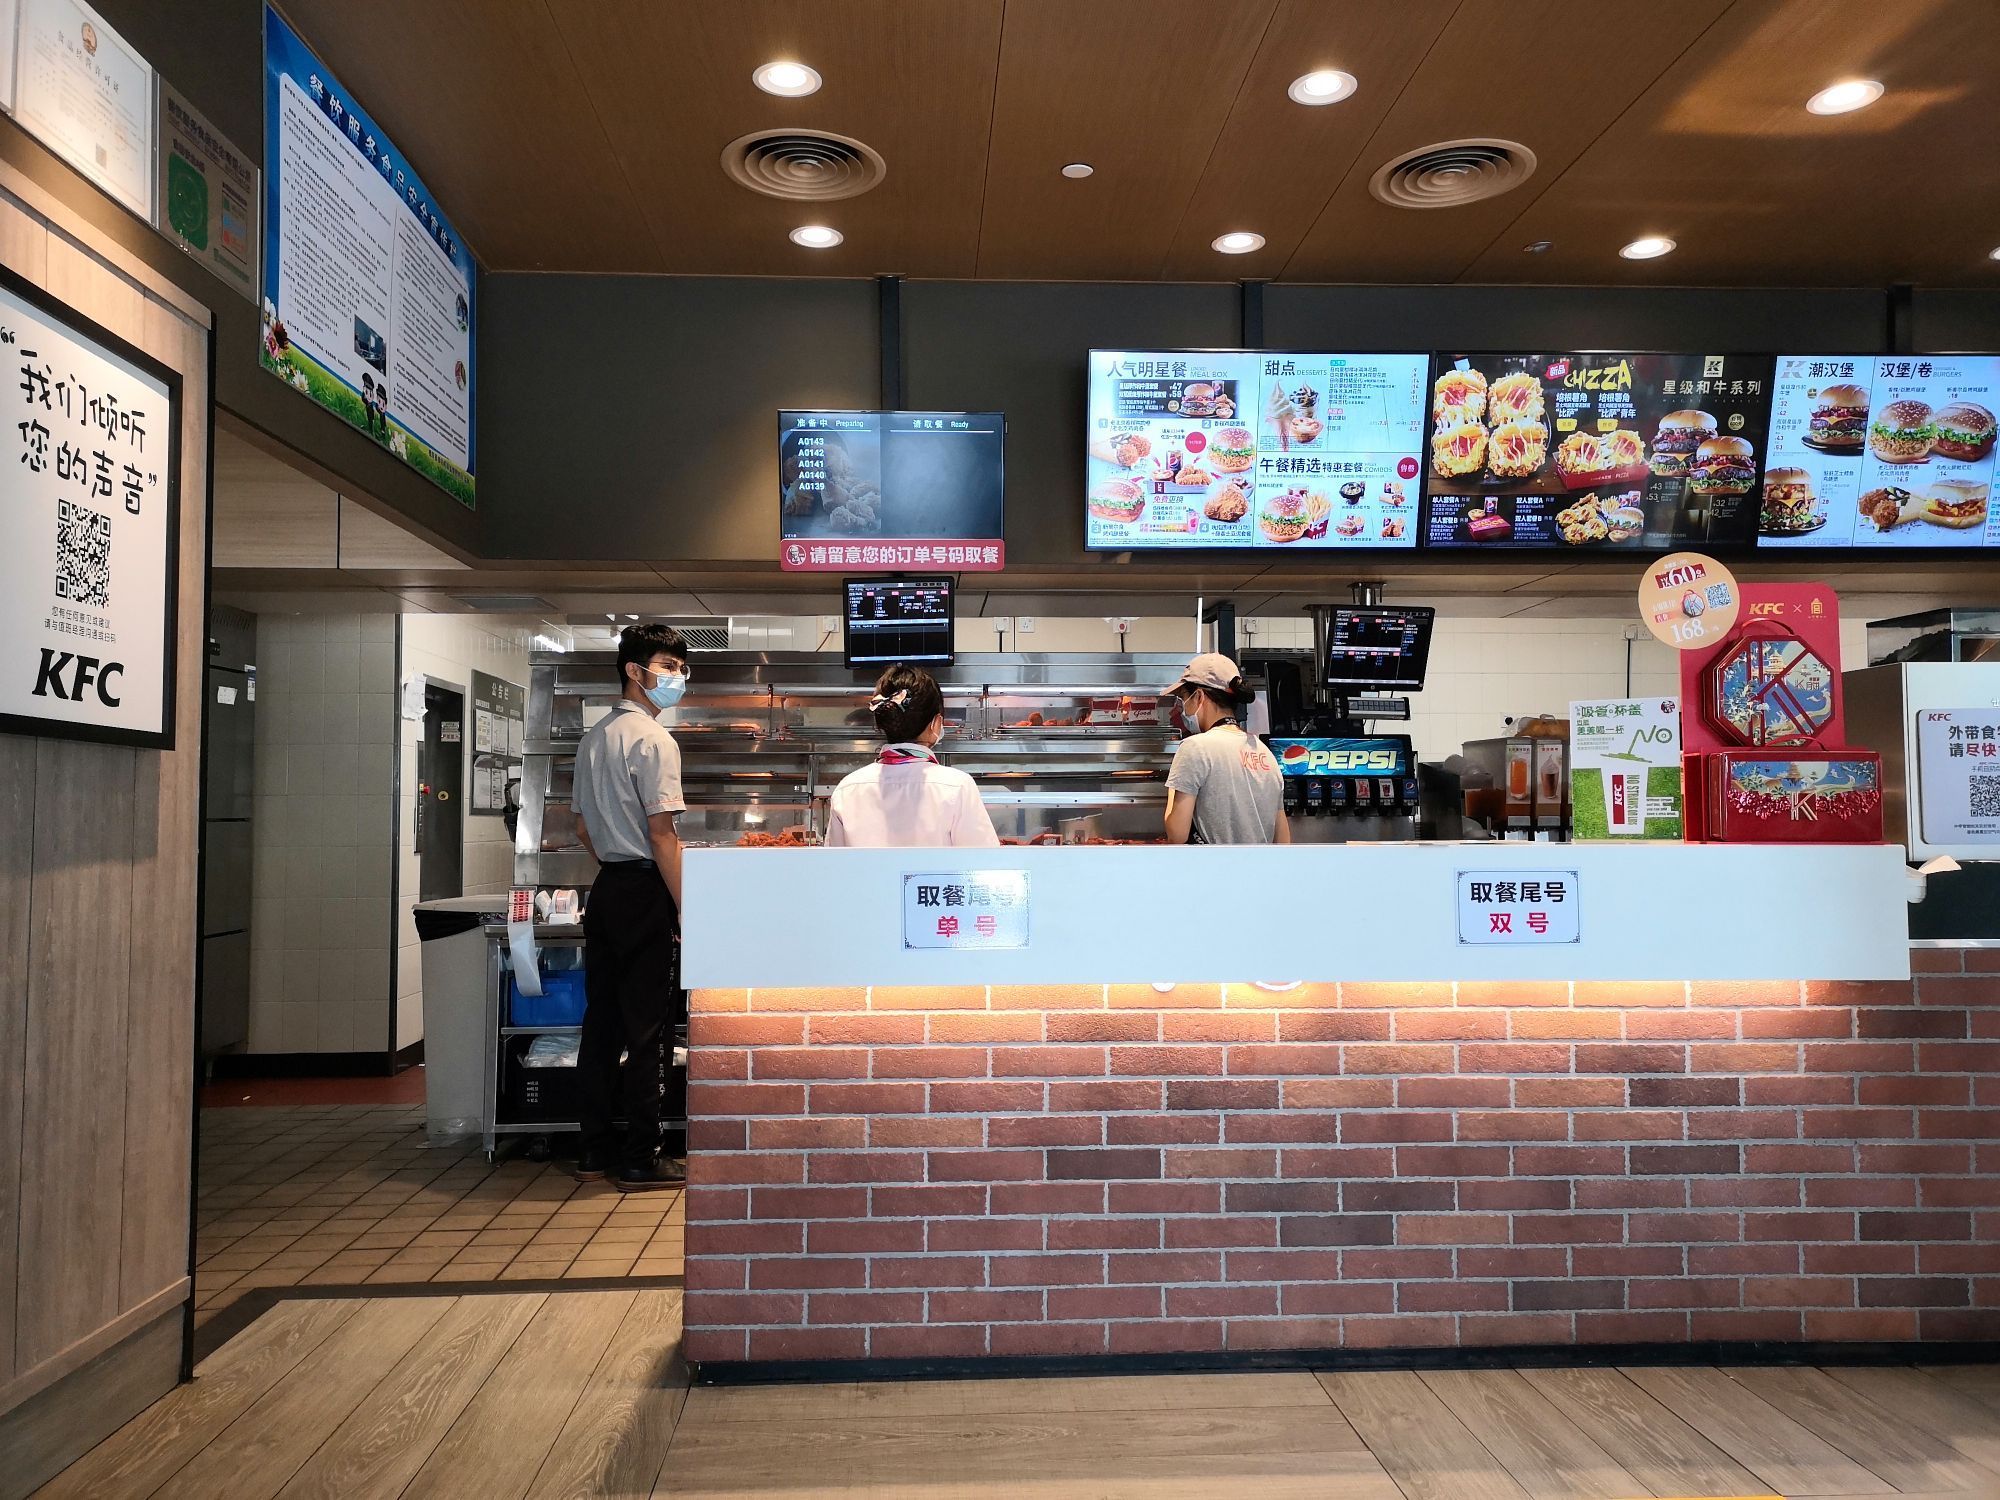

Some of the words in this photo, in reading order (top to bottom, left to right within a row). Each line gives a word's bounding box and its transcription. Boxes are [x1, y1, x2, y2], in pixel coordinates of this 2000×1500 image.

[1107, 360, 1188, 378] 人气明星餐
[1264, 360, 1296, 376] 甜点
[1808, 362, 1854, 378] 潮汉堡
[1880, 362, 1932, 380] 汉堡/卷
[1662, 380, 1762, 396] 星级和牛系列
[796, 418, 828, 428] 准备中
[835, 419, 864, 429] Preparing
[912, 419, 943, 429] 请取餐
[950, 420, 969, 429] Ready
[798, 437, 825, 446] A0143
[798, 448, 825, 457] A0142
[798, 459, 825, 468] A0141
[798, 470, 826, 479] A0140
[798, 482, 826, 491] A0139
[809, 545, 999, 565] 请留意您的订单号码取餐
[1749, 603, 1785, 615] KFC
[1670, 619, 1705, 644] 168
[31, 647, 125, 708] KFC
[1928, 713, 1952, 721] KFC
[1948, 743, 2000, 758] 请尽快
[1239, 749, 1272, 772] KFC
[1306, 750, 1398, 770] PEPSI
[1613, 784, 1623, 806] KFC
[1470, 881, 1567, 904] 取餐尾号
